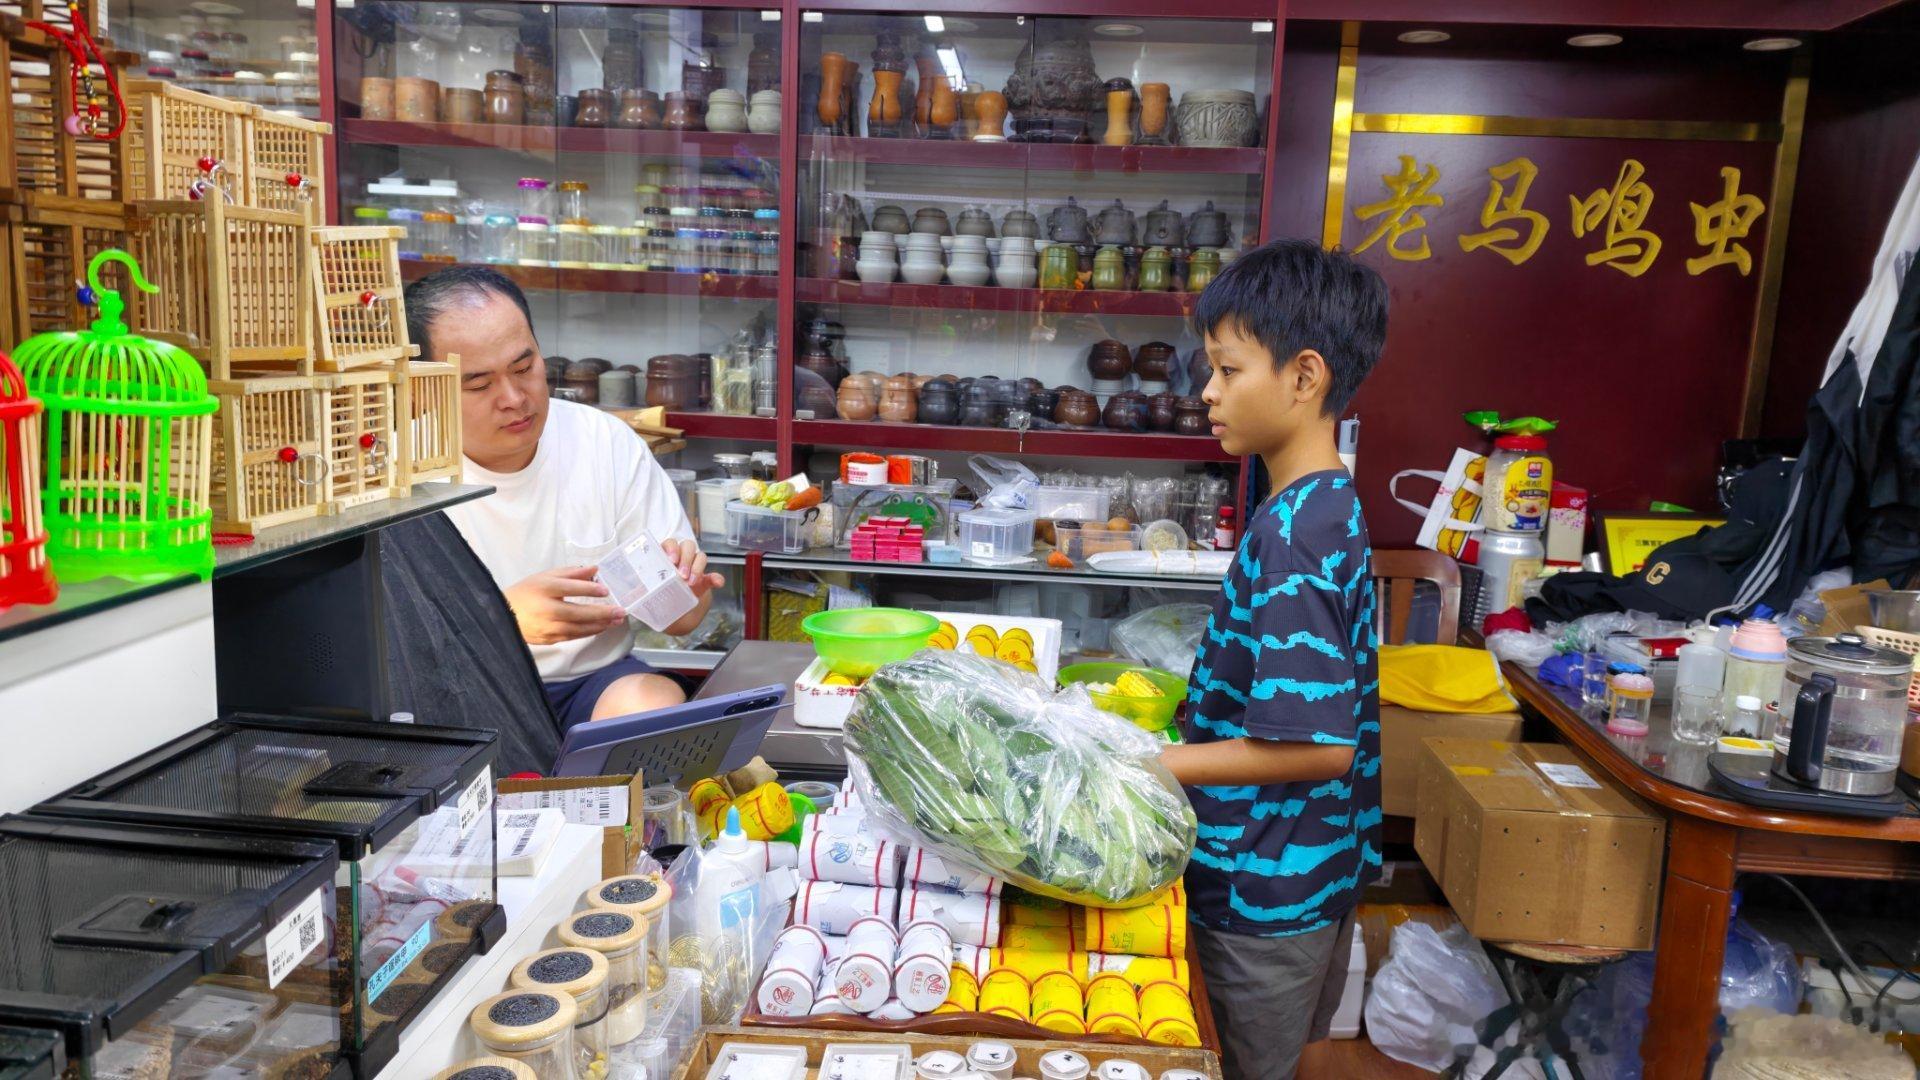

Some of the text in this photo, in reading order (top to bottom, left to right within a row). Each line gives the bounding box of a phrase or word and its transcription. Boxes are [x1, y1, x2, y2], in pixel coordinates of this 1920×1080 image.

[1353, 154, 1766, 277] 老马鸣虫
[1646, 561, 1671, 586] C
